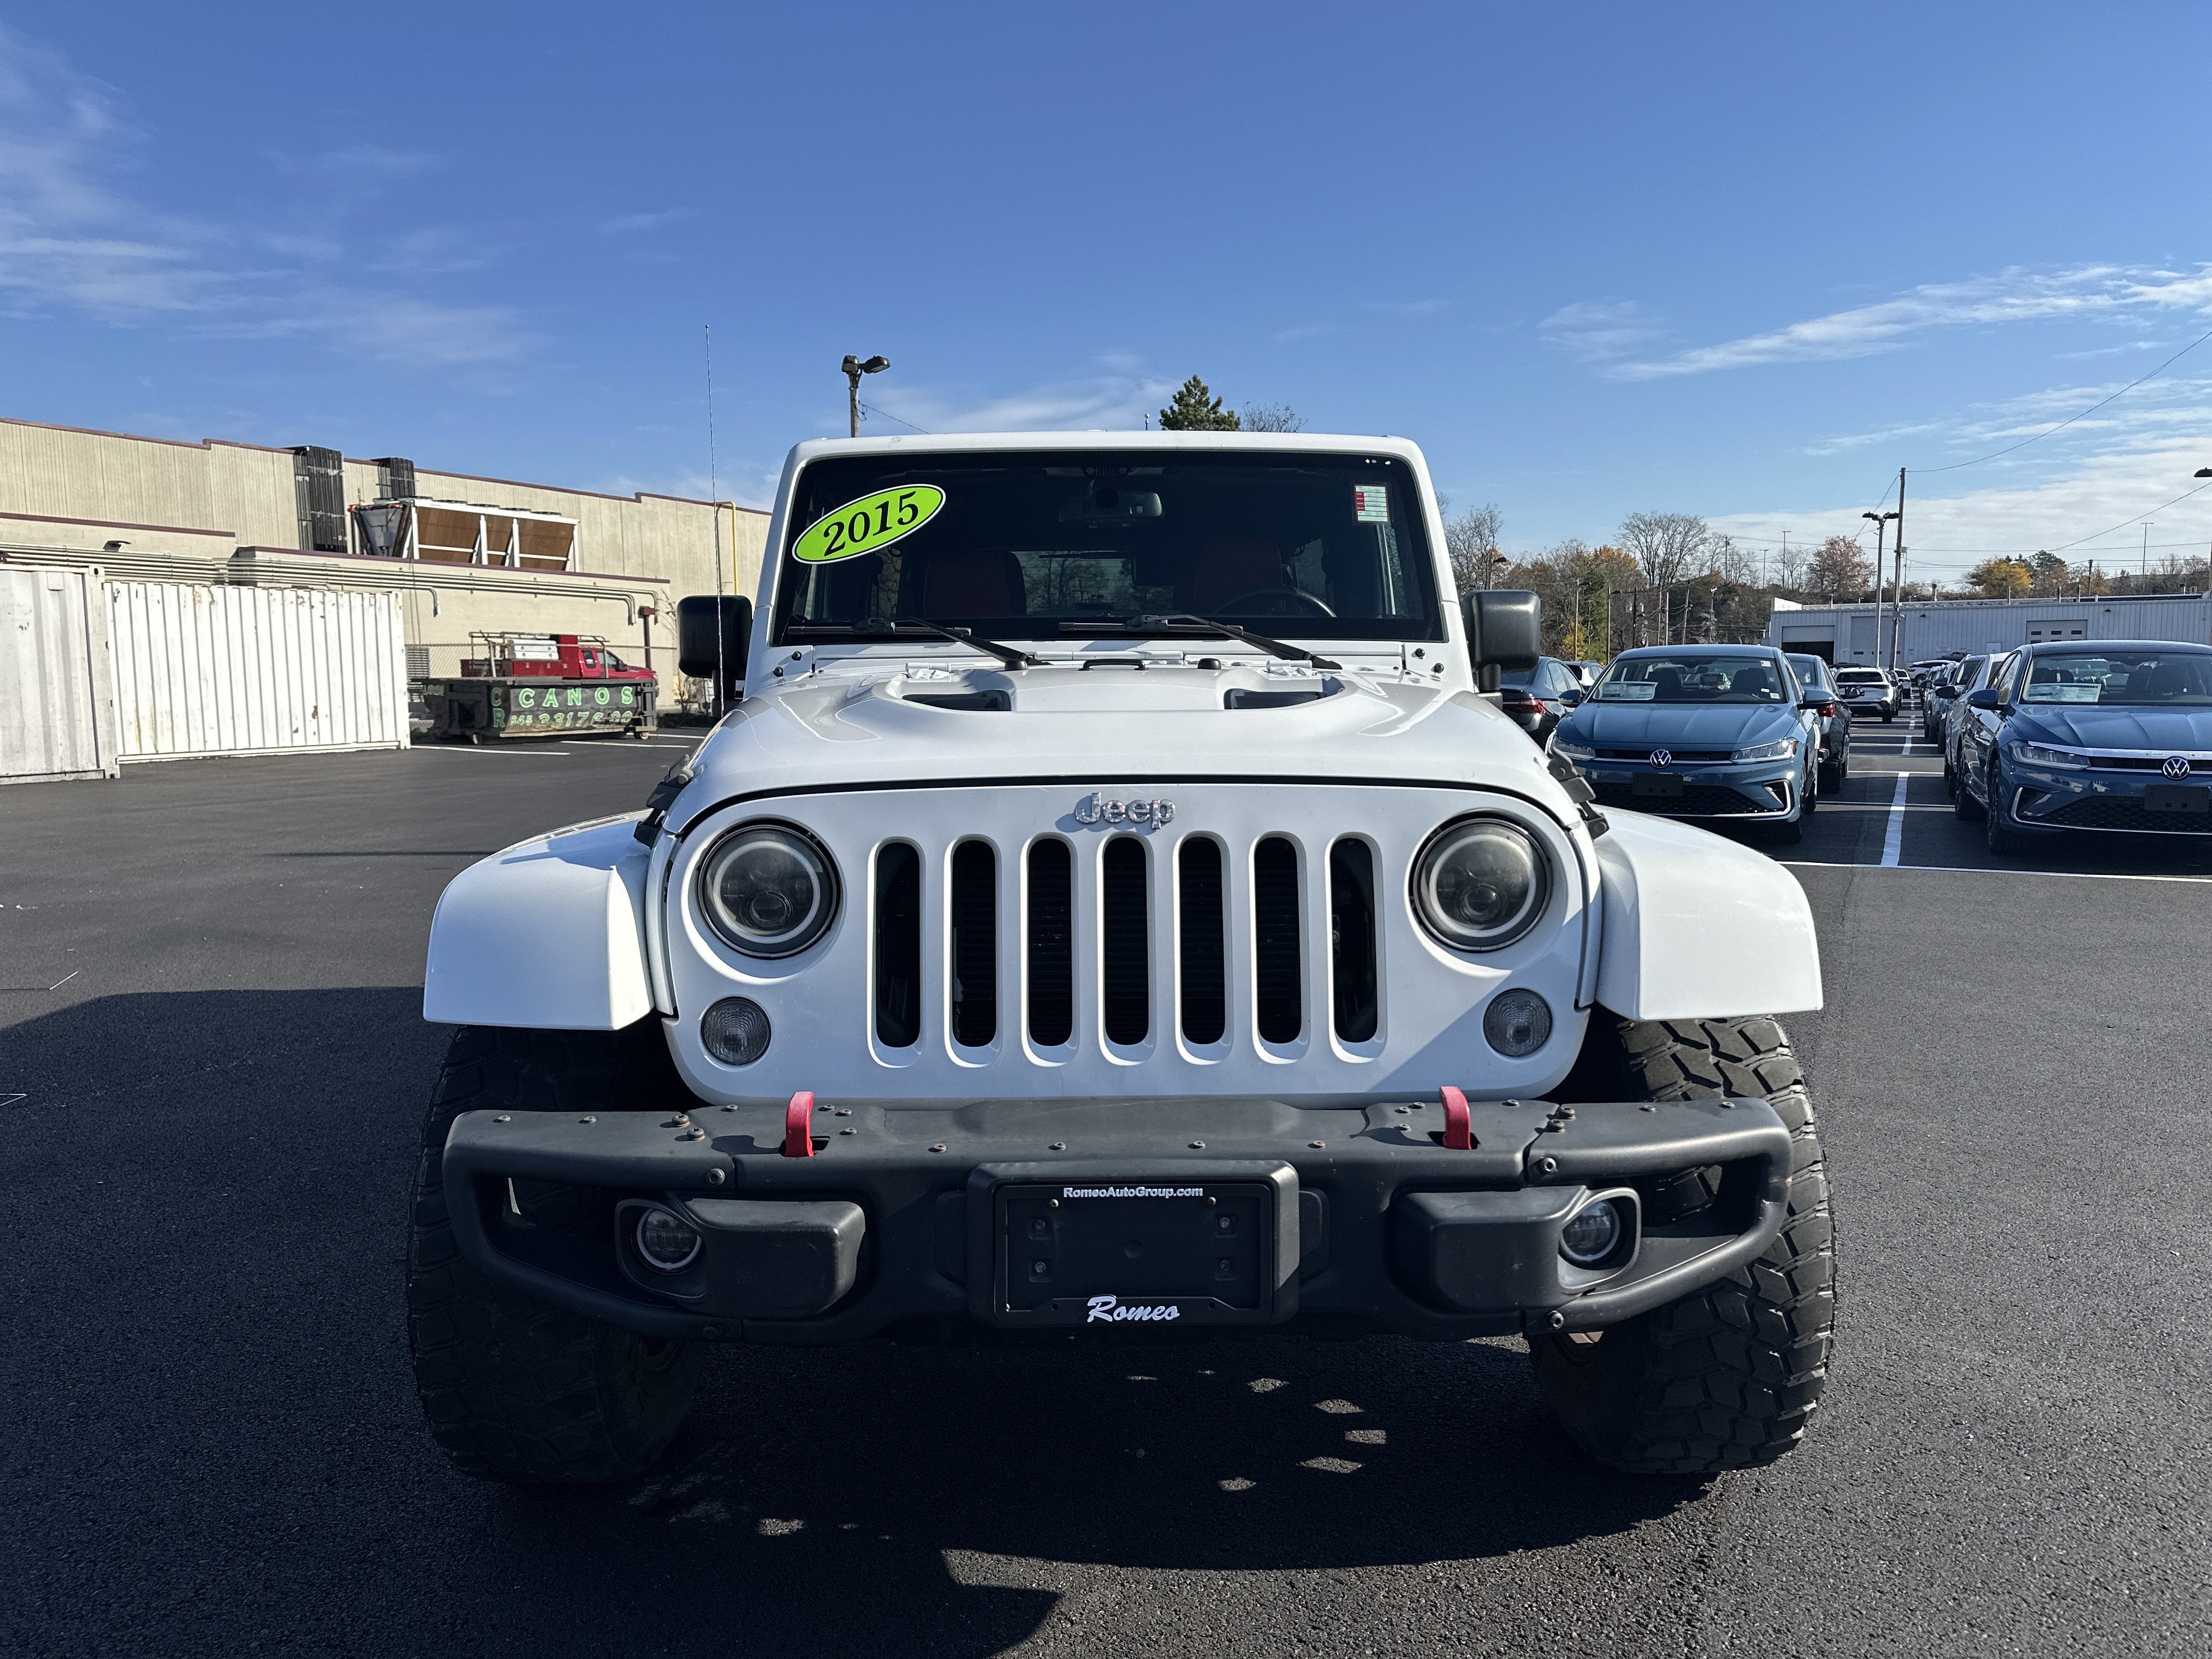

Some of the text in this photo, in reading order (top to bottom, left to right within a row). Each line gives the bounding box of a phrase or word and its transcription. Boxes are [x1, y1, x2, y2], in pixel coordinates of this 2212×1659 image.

[823, 490, 919, 556] 2015
[518, 686, 633, 708] CANOS
[1074, 792, 1176, 830] Jeep
[1063, 1187, 1203, 1198] RomeoAutoGroup.com
[1087, 1295, 1180, 1323] Romeo
